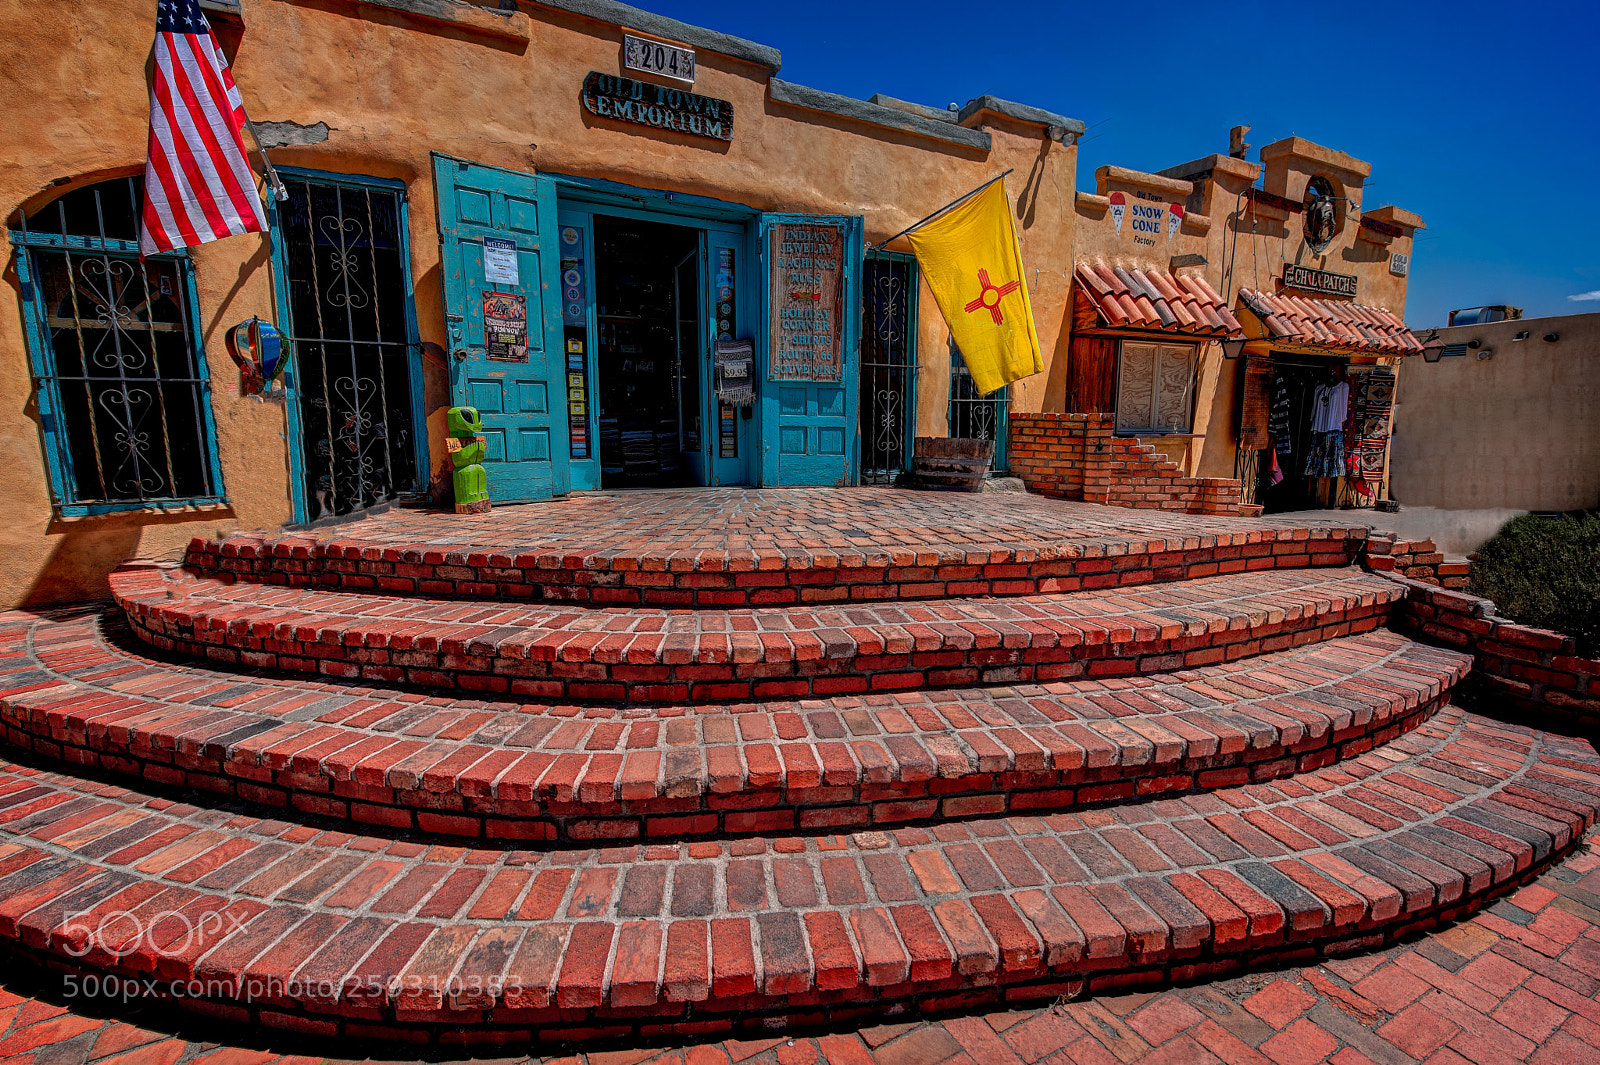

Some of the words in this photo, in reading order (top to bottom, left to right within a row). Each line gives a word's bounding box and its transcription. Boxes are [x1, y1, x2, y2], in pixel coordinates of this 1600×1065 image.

[641, 45, 678, 74] 204
[598, 75, 643, 100] OLD
[655, 86, 719, 118] TOWN
[597, 96, 722, 138] EMPORIUM
[1136, 190, 1146, 199] Old
[1148, 192, 1163, 202] Town
[1132, 204, 1165, 220] SNOW
[1132, 219, 1161, 234] CONE
[785, 230, 829, 242] INDIAN
[1133, 235, 1156, 247] Factory
[780, 243, 834, 255] JEWELRY
[777, 257, 837, 270] KACHINAS
[791, 273, 822, 285] RUGS
[1323, 274, 1350, 292] PATCH
[781, 308, 831, 319] HOLIDAY
[782, 320, 830, 331] CORNER
[780, 335, 832, 345] T-SHIRTS
[779, 350, 816, 360] ROUTE
[820, 350, 833, 360] 66
[774, 364, 837, 375] SOUVENIRS
